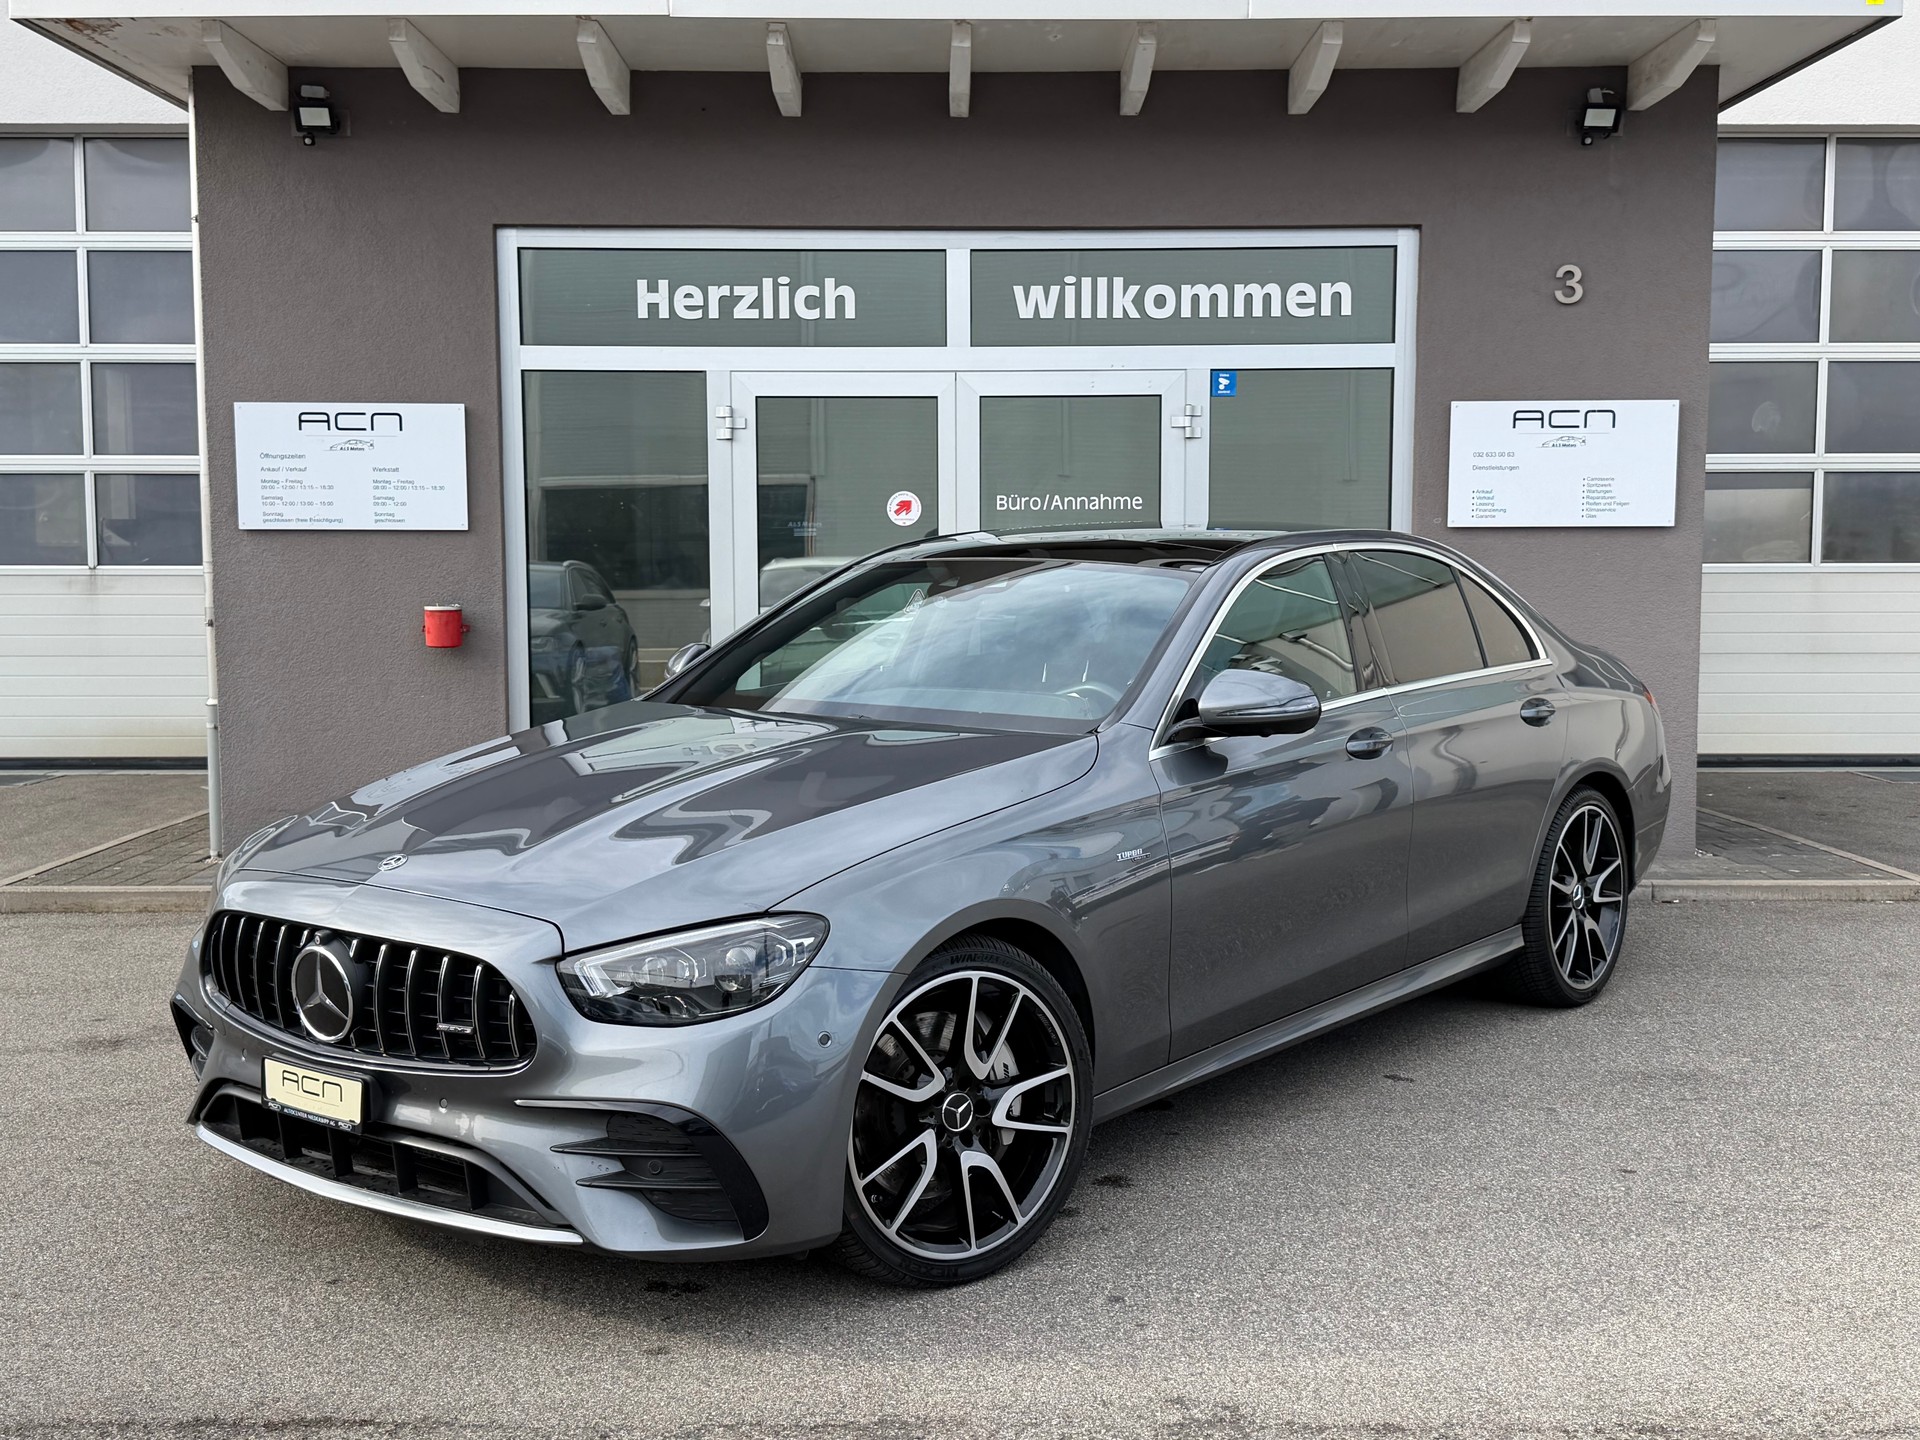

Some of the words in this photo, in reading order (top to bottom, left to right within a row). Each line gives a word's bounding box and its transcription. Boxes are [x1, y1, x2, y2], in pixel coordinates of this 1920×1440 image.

[1554, 264, 1584, 304] 3
[637, 276, 856, 320] Herzlich
[1013, 276, 1352, 319] willkommen
[259, 452, 306, 460] Öffnungszeiten
[995, 493, 1144, 511] Büro/Annahme
[1116, 848, 1143, 861] TURBO
